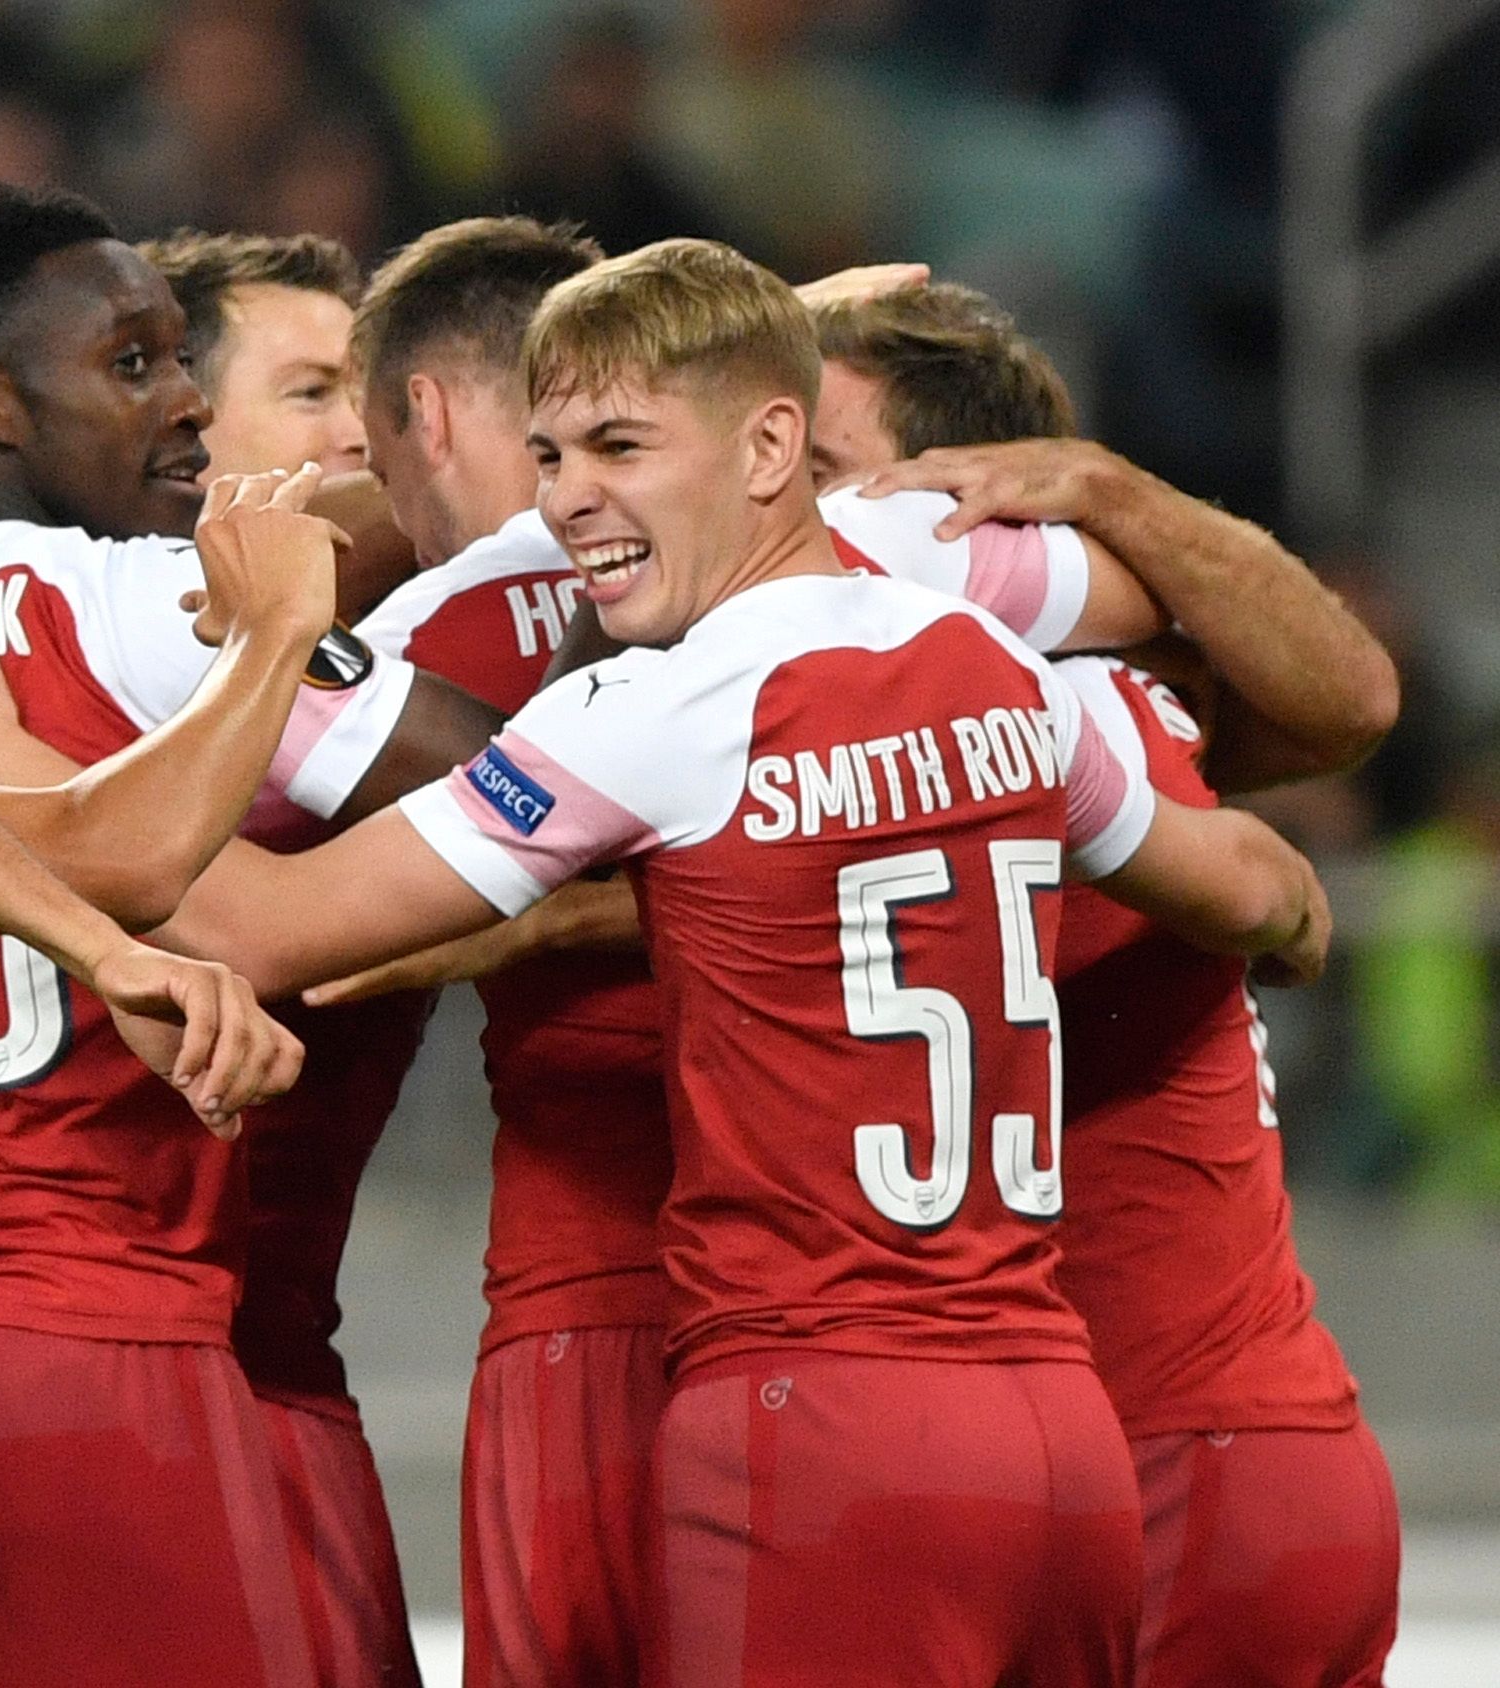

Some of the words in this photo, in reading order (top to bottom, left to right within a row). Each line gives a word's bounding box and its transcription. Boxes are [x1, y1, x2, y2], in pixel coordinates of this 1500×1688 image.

[473, 756, 547, 823] RESPECT
[743, 728, 952, 842] SMITH
[837, 839, 1062, 1226] 55
